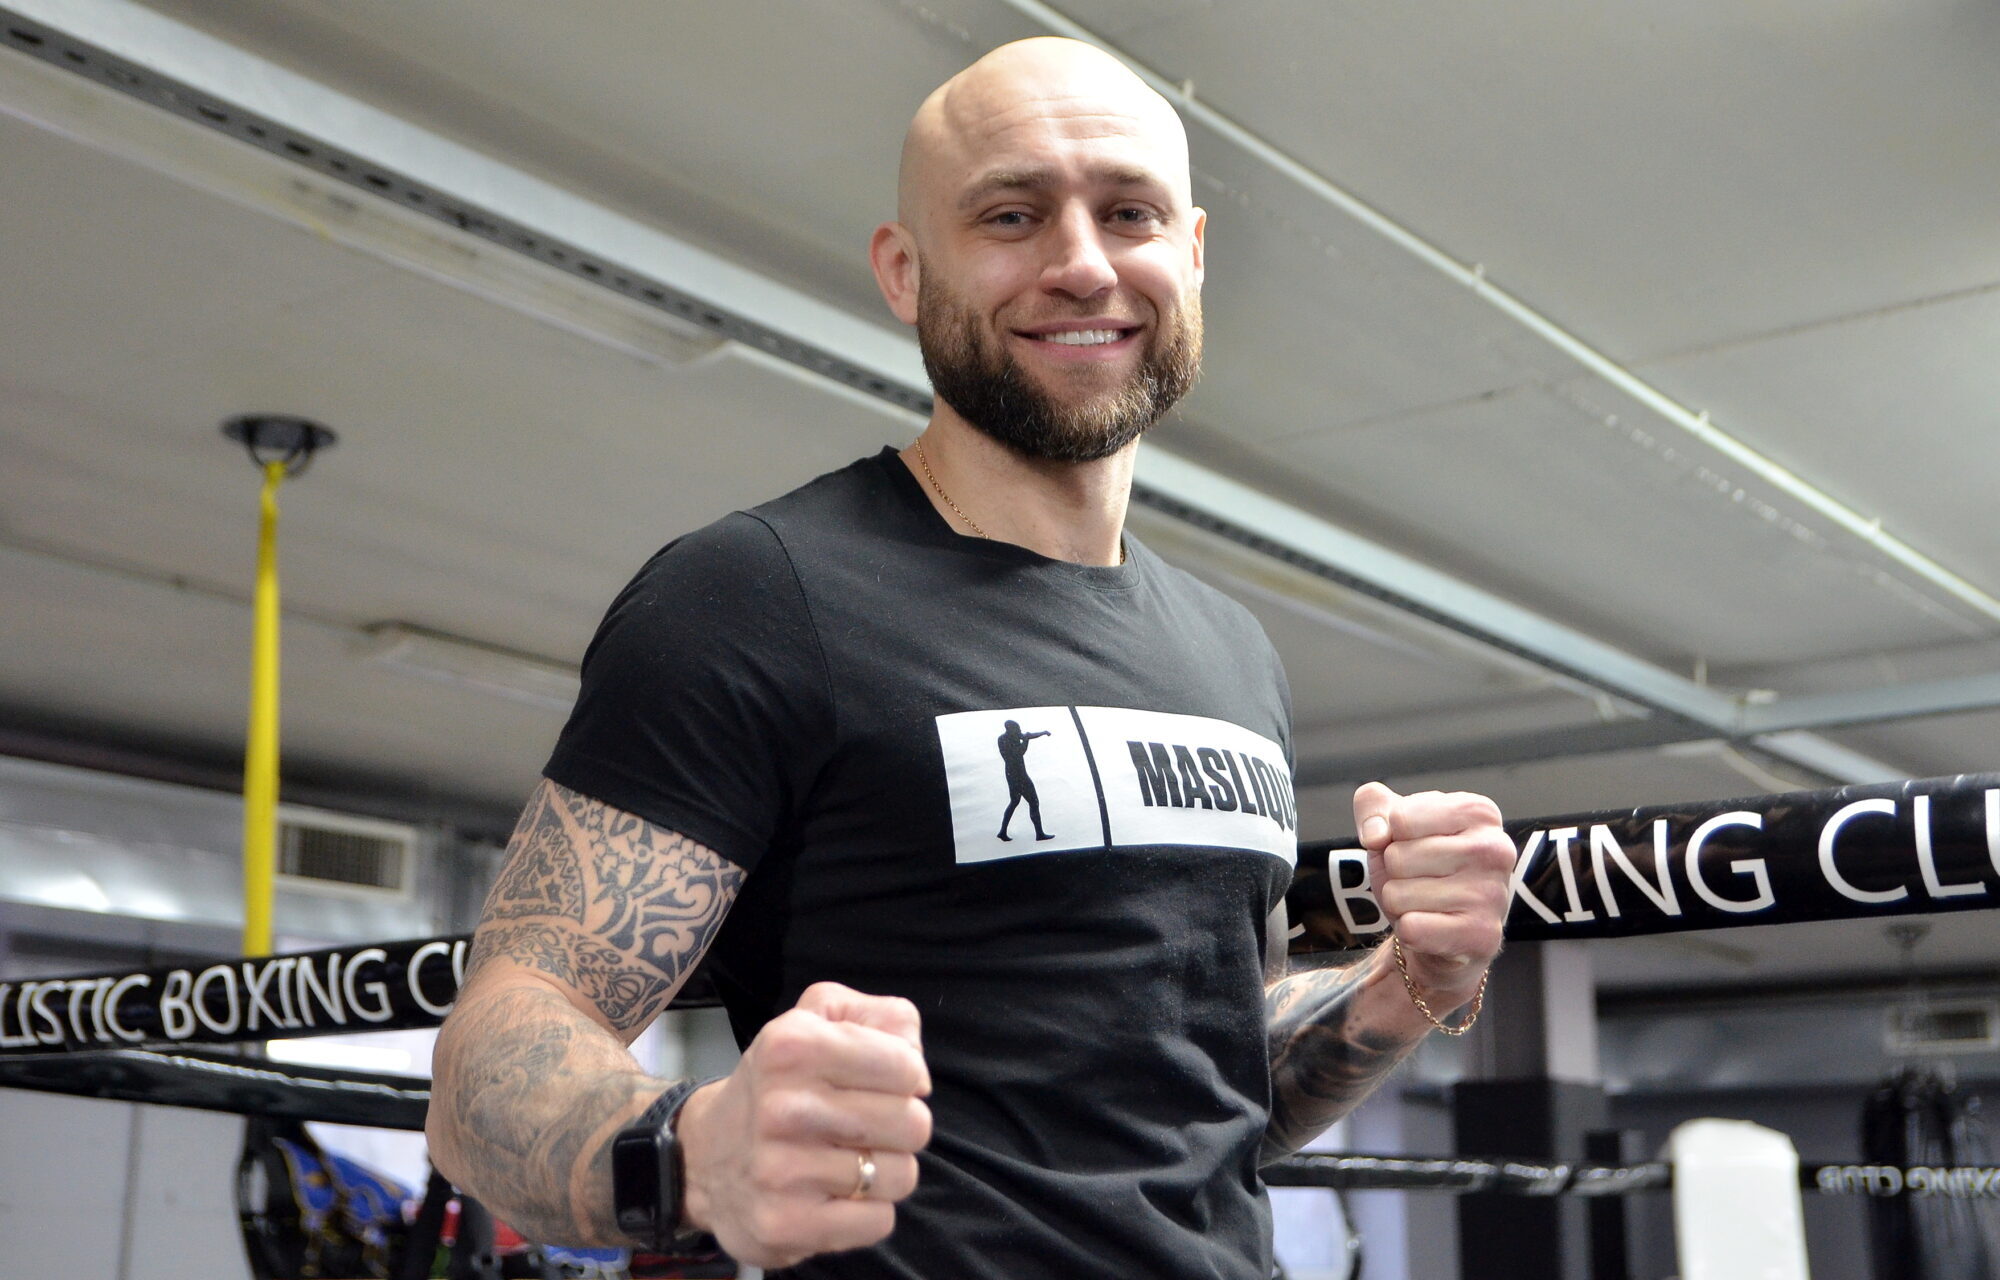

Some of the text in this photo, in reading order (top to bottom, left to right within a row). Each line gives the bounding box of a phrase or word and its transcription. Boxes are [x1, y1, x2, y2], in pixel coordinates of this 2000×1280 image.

[1126, 741, 1297, 832] MASLIQU
[1328, 788, 2000, 934] BXING CL
[160, 949, 394, 1039] BOXING
